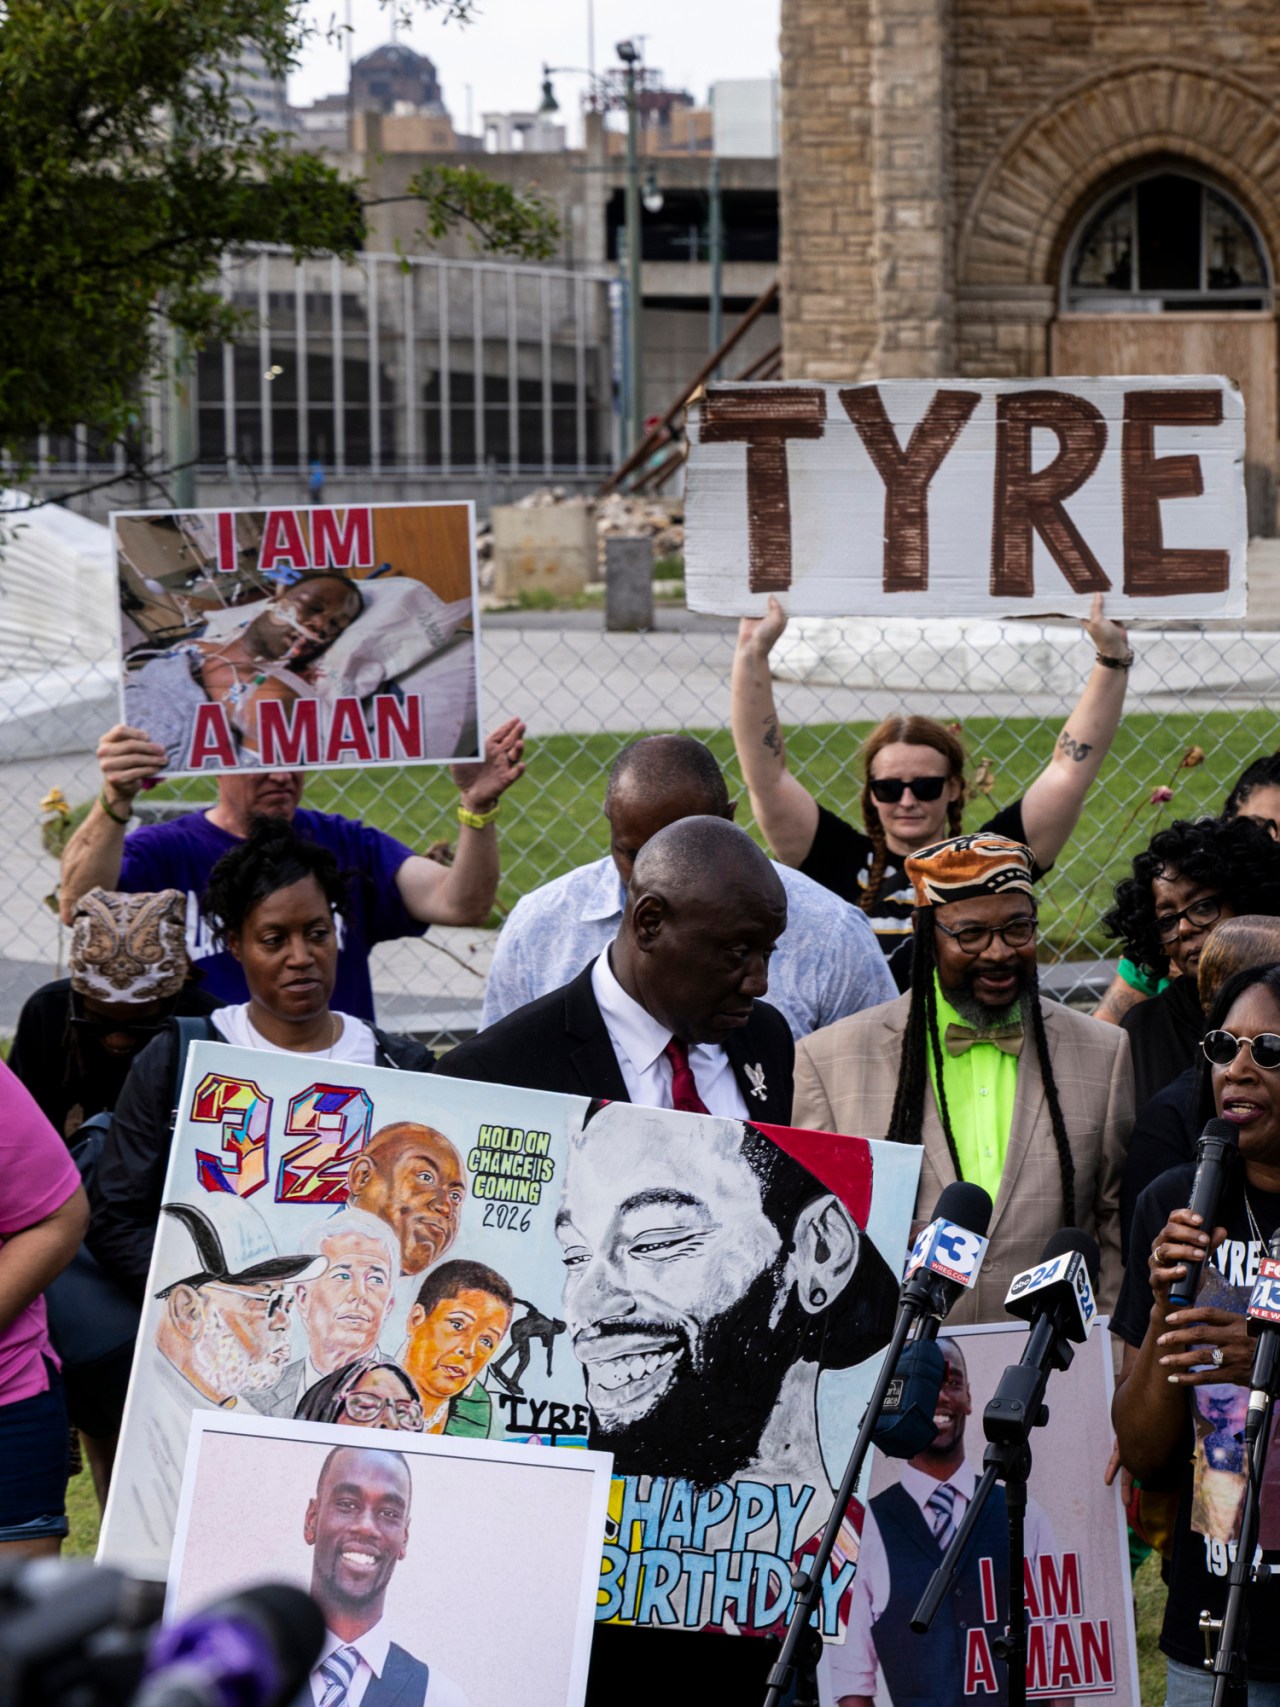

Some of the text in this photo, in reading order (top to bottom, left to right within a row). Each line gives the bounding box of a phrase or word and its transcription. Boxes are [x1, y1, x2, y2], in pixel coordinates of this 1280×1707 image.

[699, 385, 1231, 598] TYRE
[217, 507, 375, 573] I AM
[187, 693, 425, 769] A MAN
[189, 1072, 374, 1204] 32
[477, 1124, 552, 1156] HOLD ON
[466, 1147, 555, 1183] CHANGE IS
[471, 1174, 541, 1206] COMING
[482, 1202, 532, 1233] 2026
[931, 1262, 969, 1284] WREG.COM
[935, 1225, 981, 1273] 3
[1208, 1238, 1262, 1287] YRE
[1012, 1278, 1030, 1291] abc
[1028, 1260, 1061, 1289] 24
[1080, 1284, 1094, 1320] 24
[500, 1392, 590, 1446] TYRE
[618, 1476, 816, 1562] HAPPY
[979, 1550, 1085, 1624] I AM
[964, 1627, 999, 1696] A
